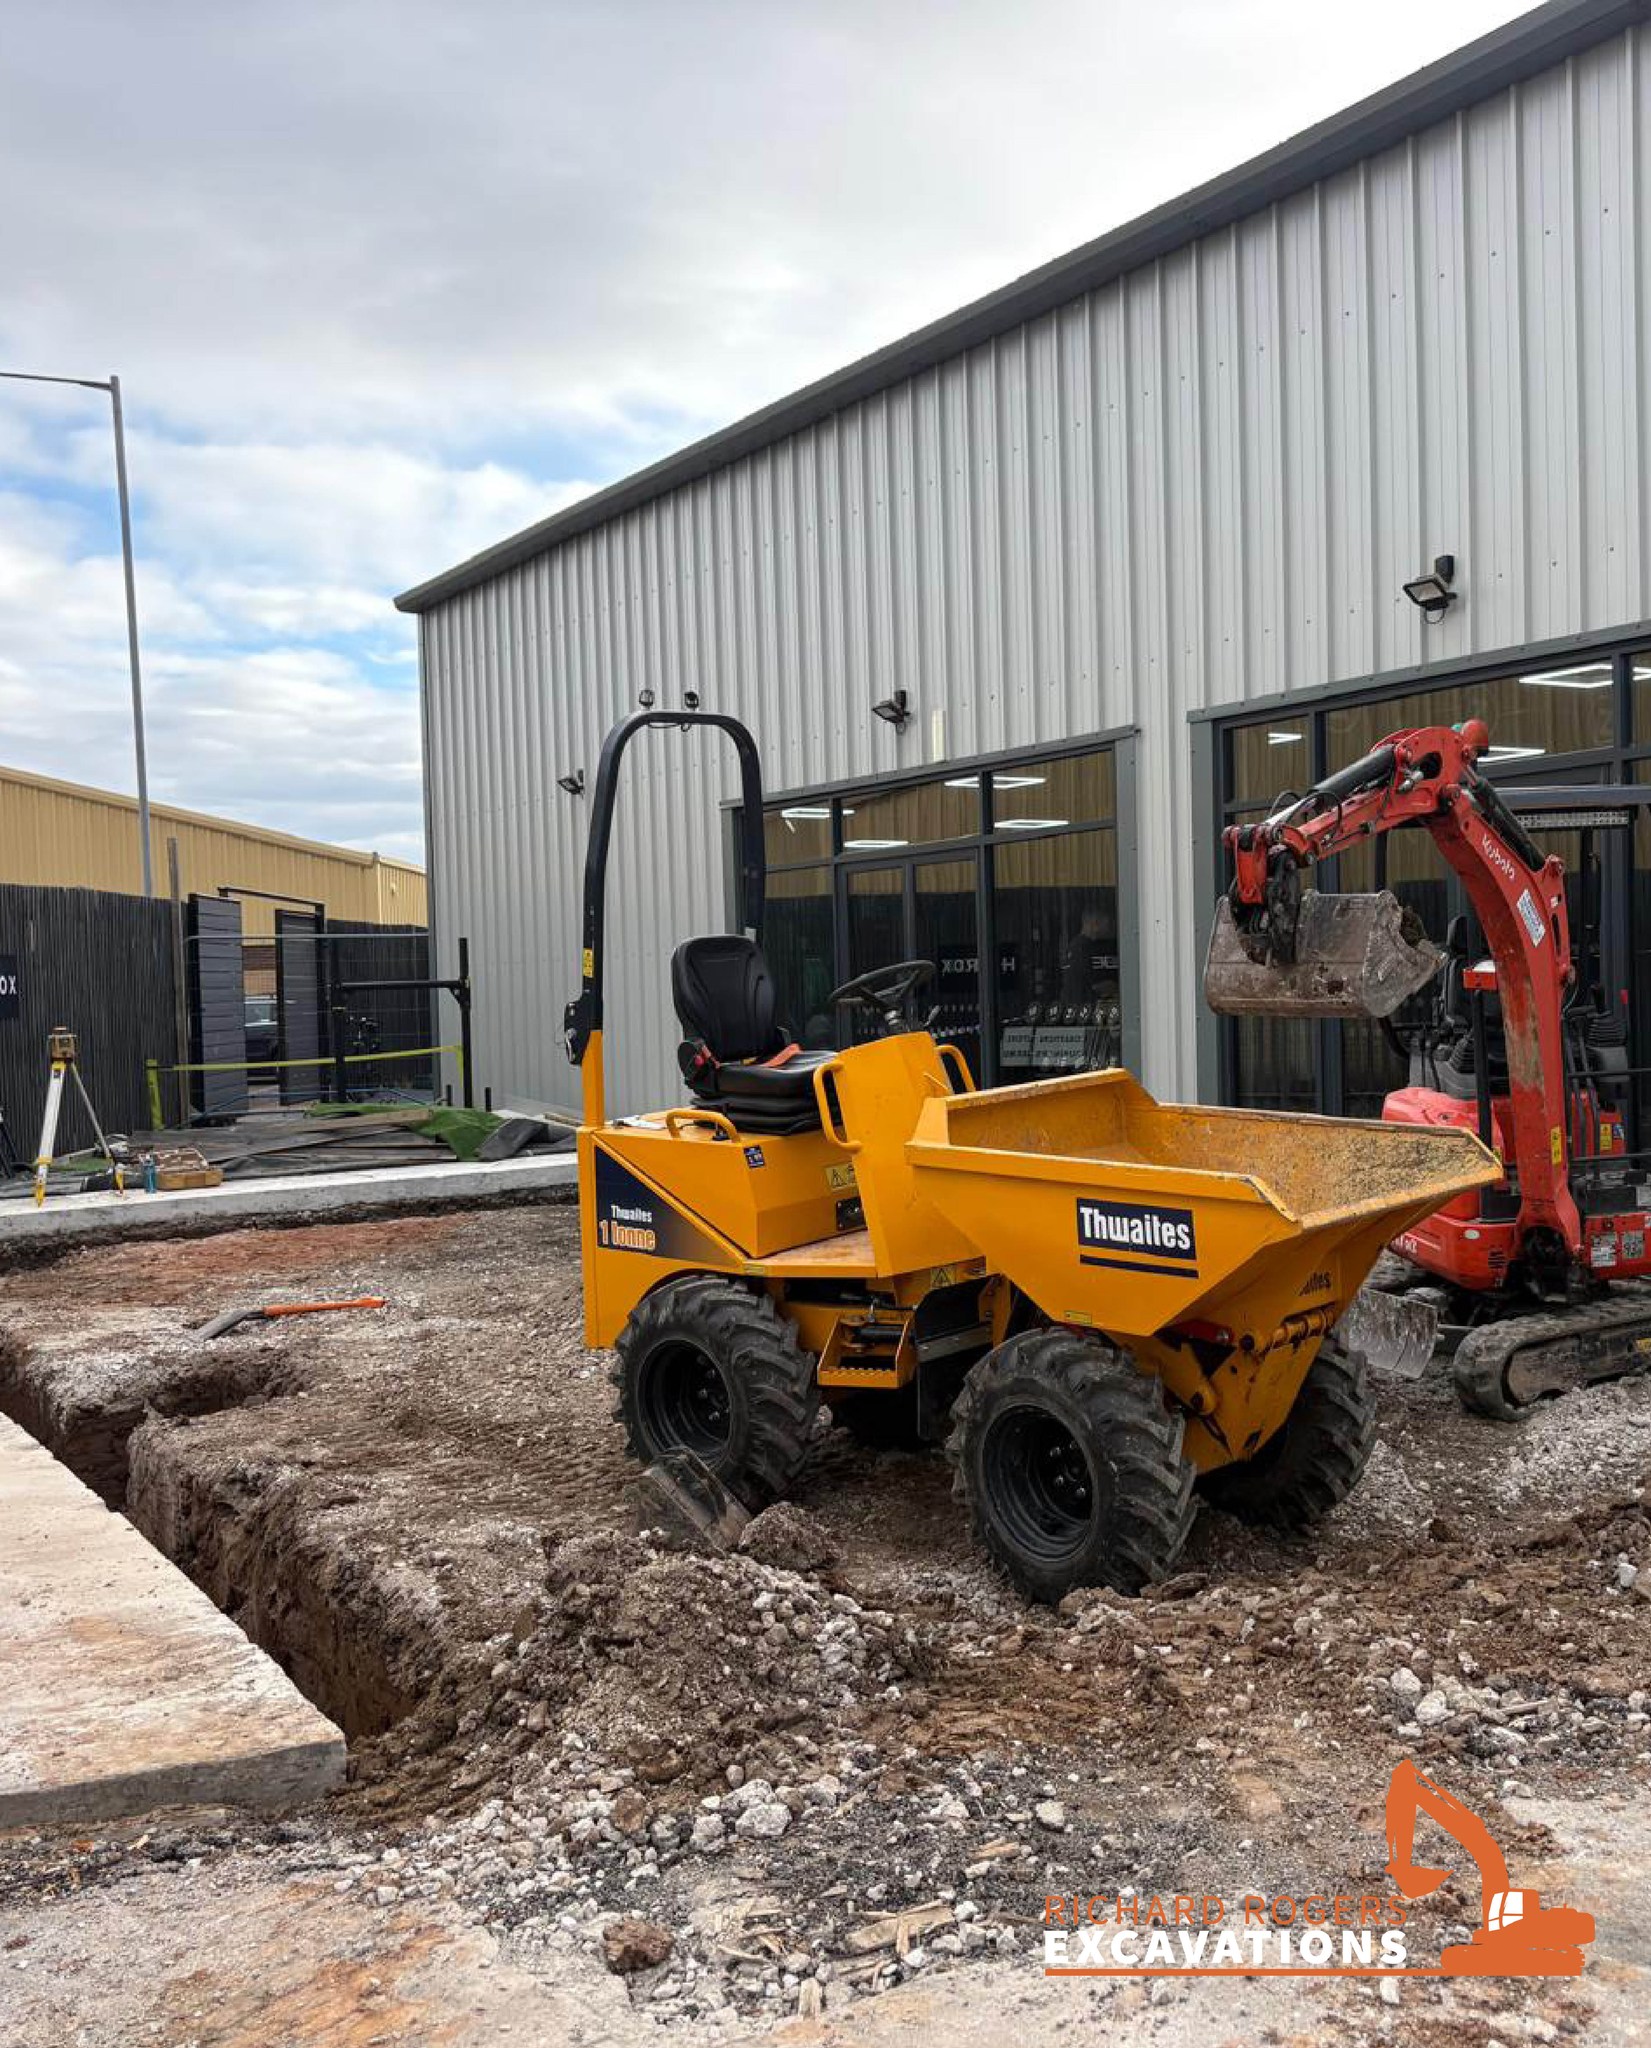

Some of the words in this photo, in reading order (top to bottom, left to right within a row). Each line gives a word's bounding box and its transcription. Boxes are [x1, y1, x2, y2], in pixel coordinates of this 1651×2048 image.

[611, 1205, 653, 1222] Thwaites
[1080, 1207, 1191, 1250] Thwaites
[599, 1220, 608, 1245] 1
[611, 1221, 656, 1250] tonne
